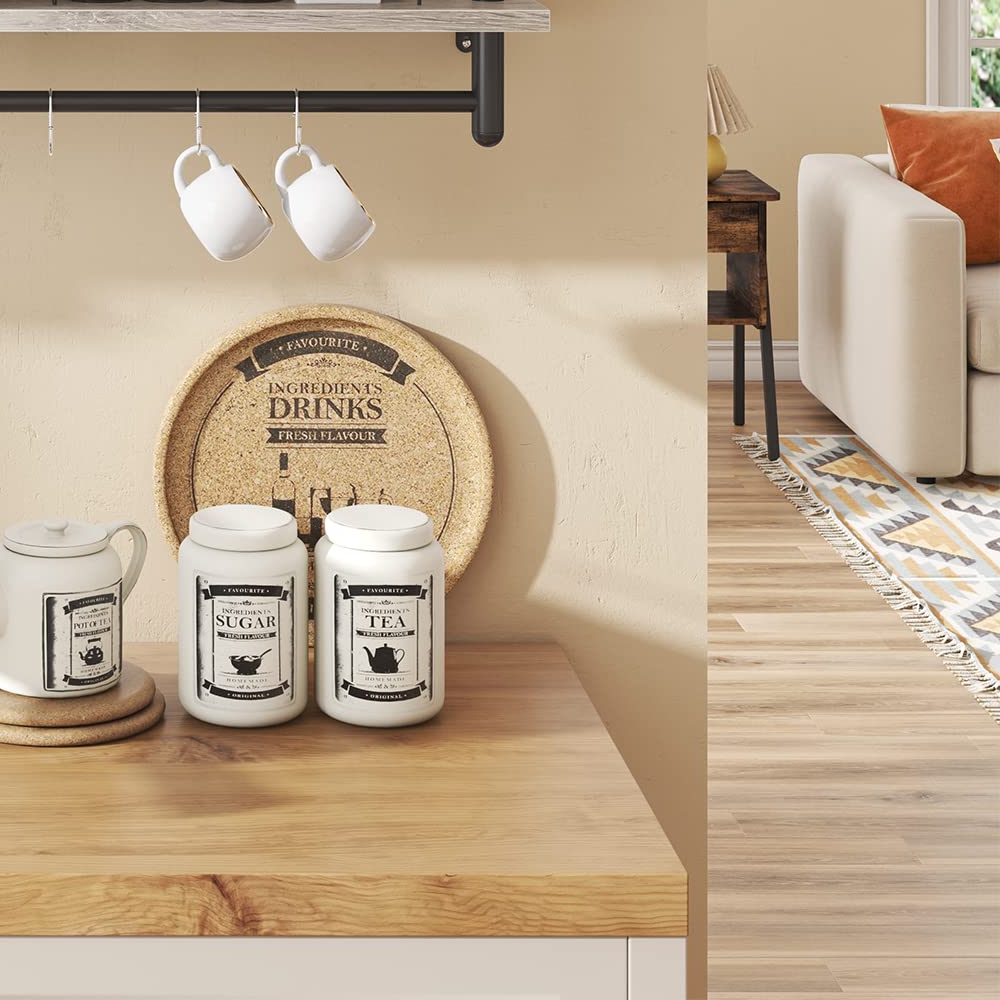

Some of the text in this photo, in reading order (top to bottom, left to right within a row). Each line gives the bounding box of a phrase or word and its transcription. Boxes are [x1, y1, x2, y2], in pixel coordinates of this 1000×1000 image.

[287, 338, 360, 351] FAVOURITE
[268, 382, 383, 395] INGREDIENTS
[268, 397, 383, 420] DRINKS
[278, 430, 376, 440] FRESH FLAVOUR
[216, 614, 276, 630] SUGAR
[365, 615, 406, 628] TEA
